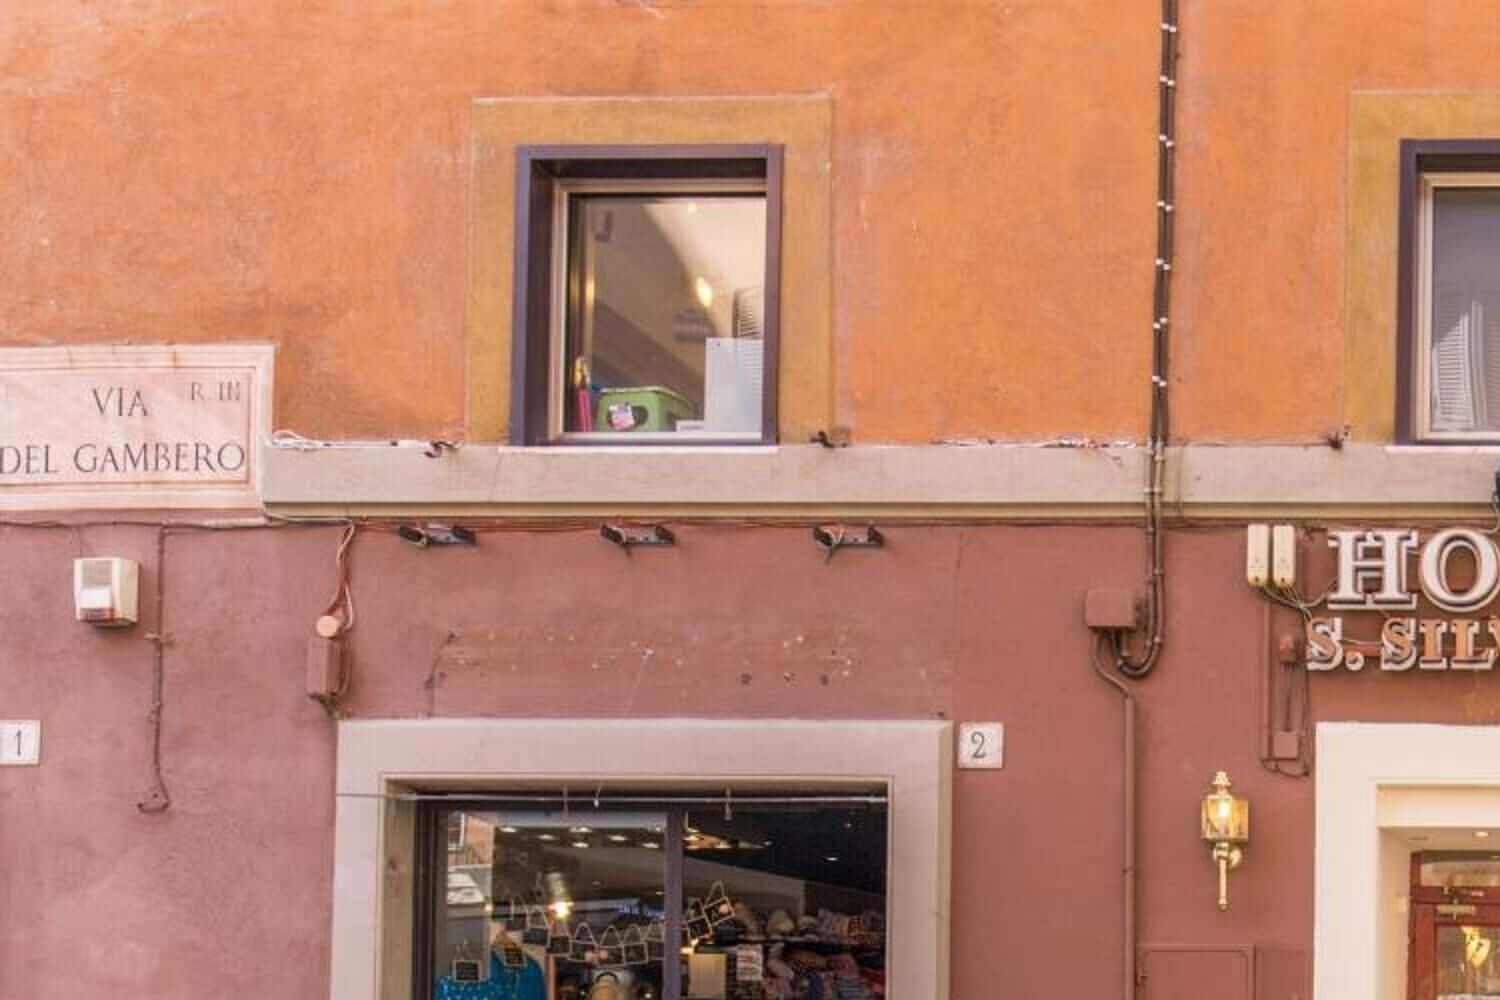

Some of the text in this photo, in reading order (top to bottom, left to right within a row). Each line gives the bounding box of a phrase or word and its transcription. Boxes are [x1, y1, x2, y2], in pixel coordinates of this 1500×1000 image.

[92, 386, 149, 417] VIA
[0, 441, 245, 475] DEL GAMBERO
[1305, 616, 1365, 672] S.
[970, 730, 988, 759] 2
